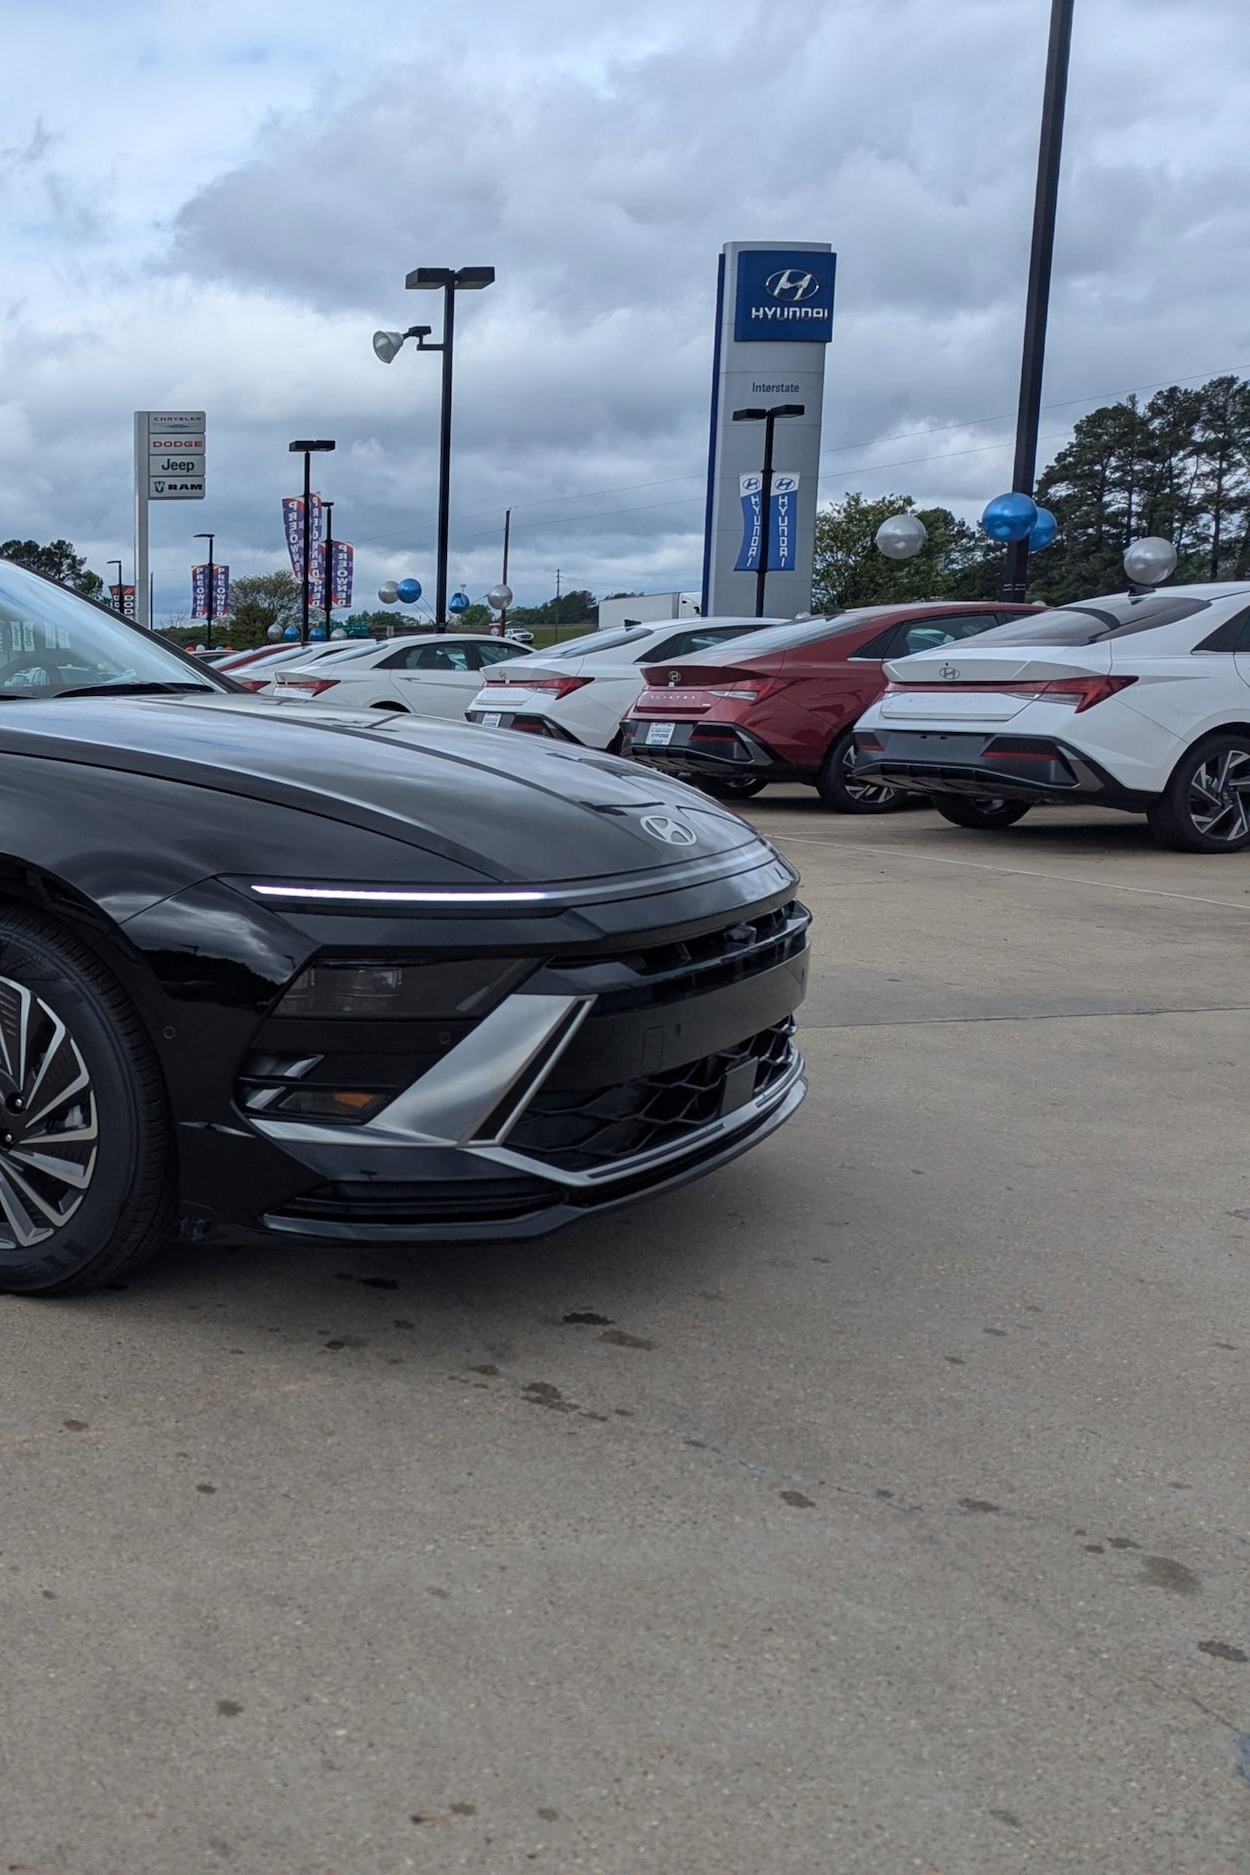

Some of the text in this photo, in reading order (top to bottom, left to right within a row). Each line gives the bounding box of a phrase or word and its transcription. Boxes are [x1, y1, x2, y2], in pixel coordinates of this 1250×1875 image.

[751, 307, 828, 320] HYUNDAI
[752, 382, 800, 393] Interstate
[161, 458, 195, 473] Jeep
[746, 495, 761, 567] HYUNDAI
[778, 496, 788, 567] HYUNDAI
[196, 567, 205, 617] PREOWNED
[216, 567, 226, 617] PREOWNED
